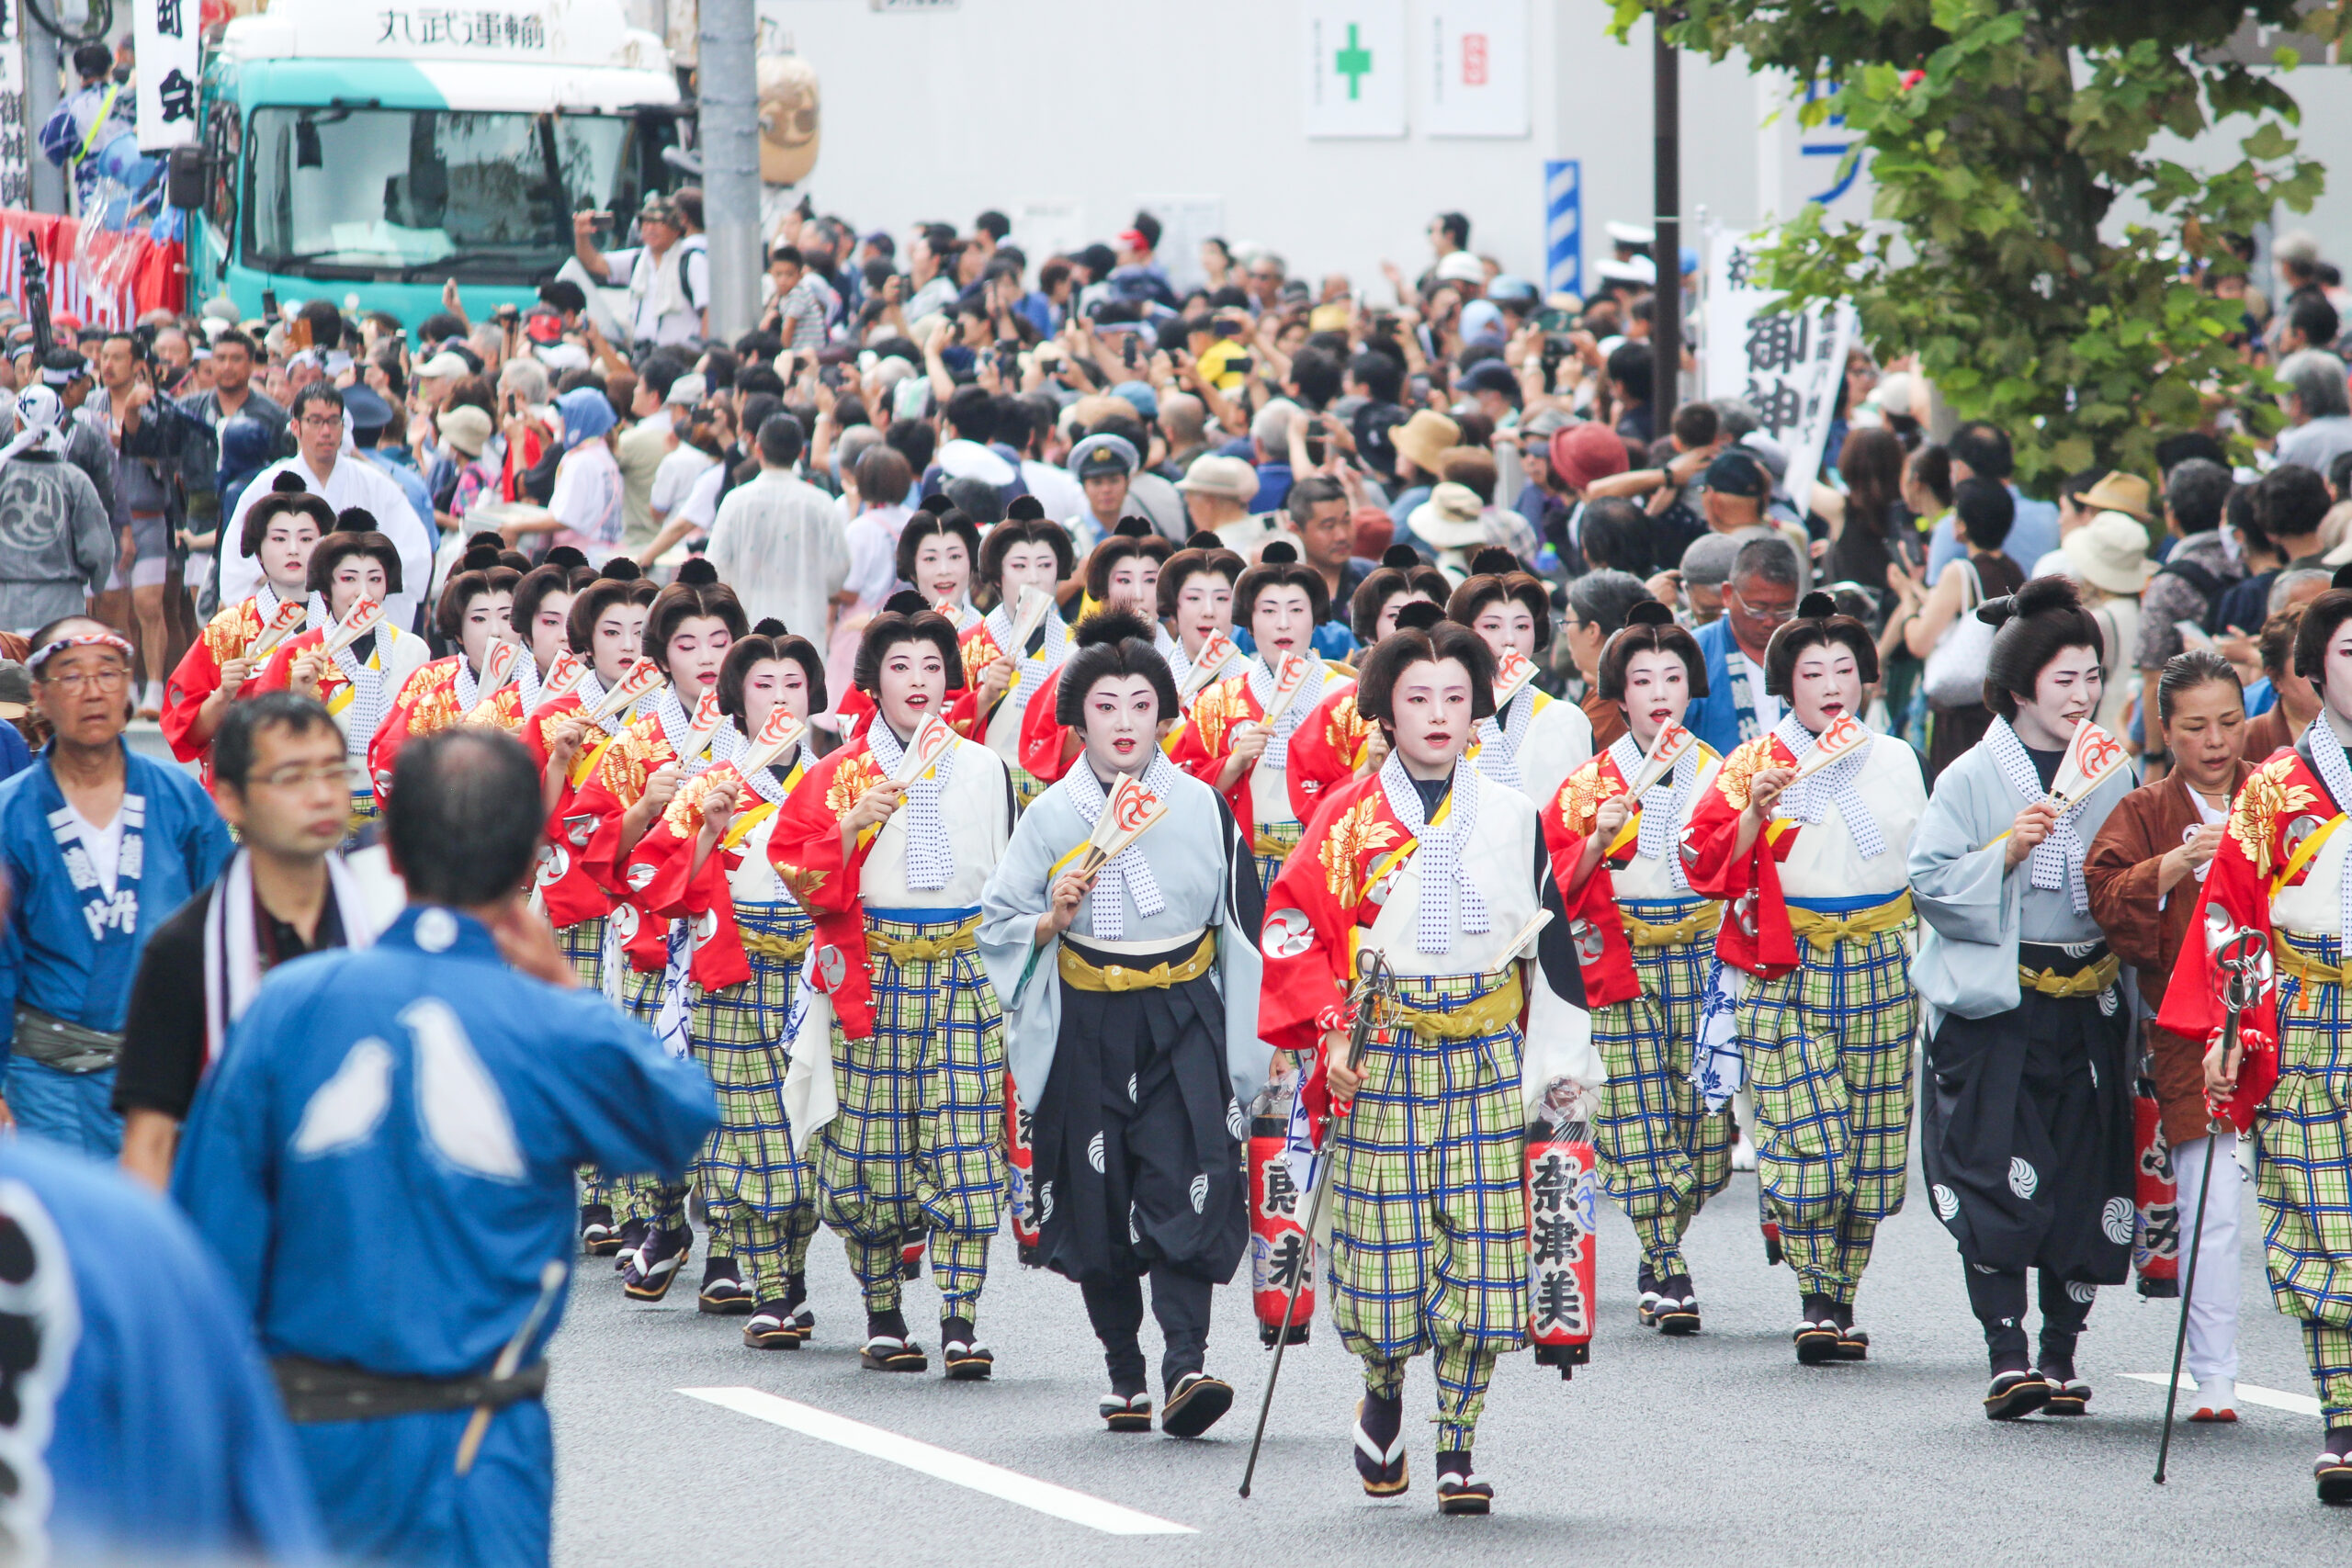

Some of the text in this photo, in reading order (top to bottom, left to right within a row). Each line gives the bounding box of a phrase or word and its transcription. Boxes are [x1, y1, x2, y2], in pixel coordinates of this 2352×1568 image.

[376, 8, 545, 50] 丸武運輸
[1532, 1155, 1580, 1330] 奈津美
